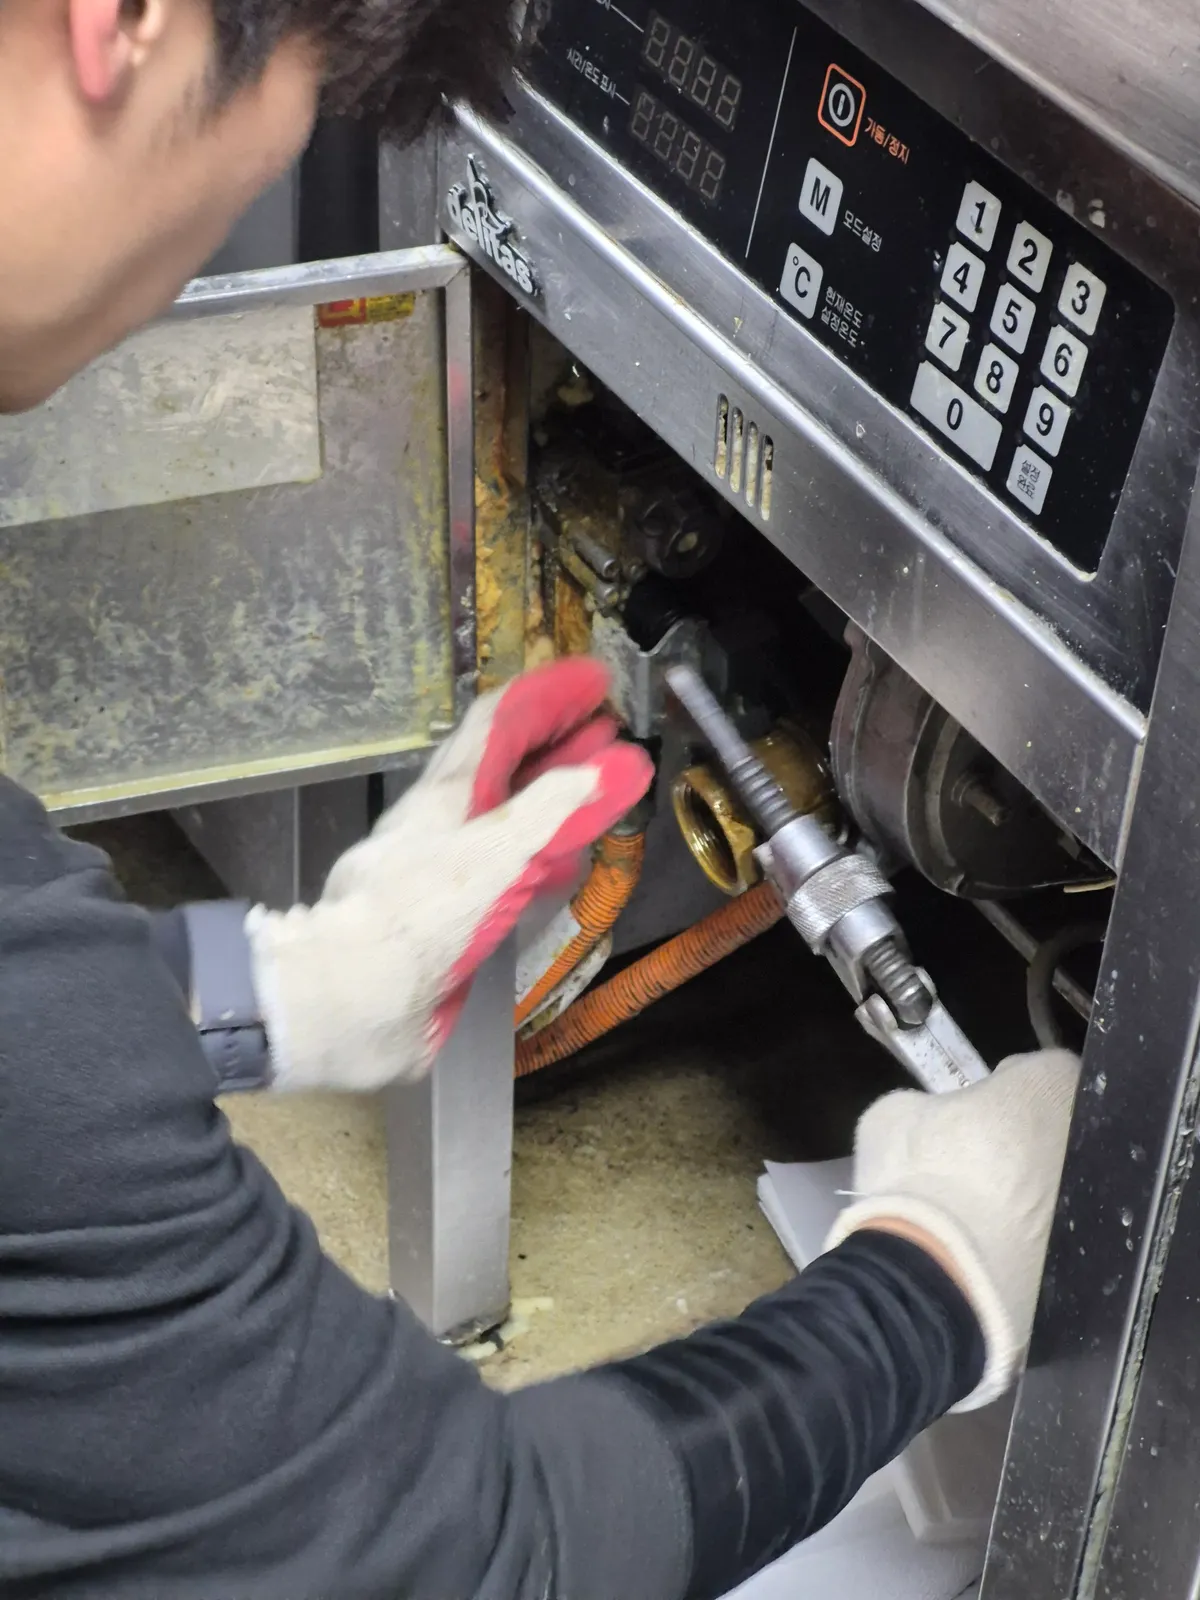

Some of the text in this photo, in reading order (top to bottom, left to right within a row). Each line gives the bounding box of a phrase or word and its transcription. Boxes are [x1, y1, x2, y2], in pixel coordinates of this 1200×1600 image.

[864, 117, 910, 164] 가동/정지
[809, 176, 831, 217] M
[843, 210, 883, 252] 모드설정
[974, 200, 987, 234] 1
[1017, 238, 1039, 276] 2
[952, 262, 971, 294] 4
[825, 286, 863, 329] 현재온도
[1071, 280, 1091, 316] 3
[821, 306, 857, 348] 설정온도
[938, 316, 957, 349] 7
[1002, 299, 1022, 334] 5
[986, 360, 1004, 394] 8
[1053, 343, 1073, 377] 6
[946, 398, 963, 431] 0
[1036, 402, 1054, 437] 9
[1017, 474, 1036, 500] 완료
[1021, 459, 1041, 483] 설정
